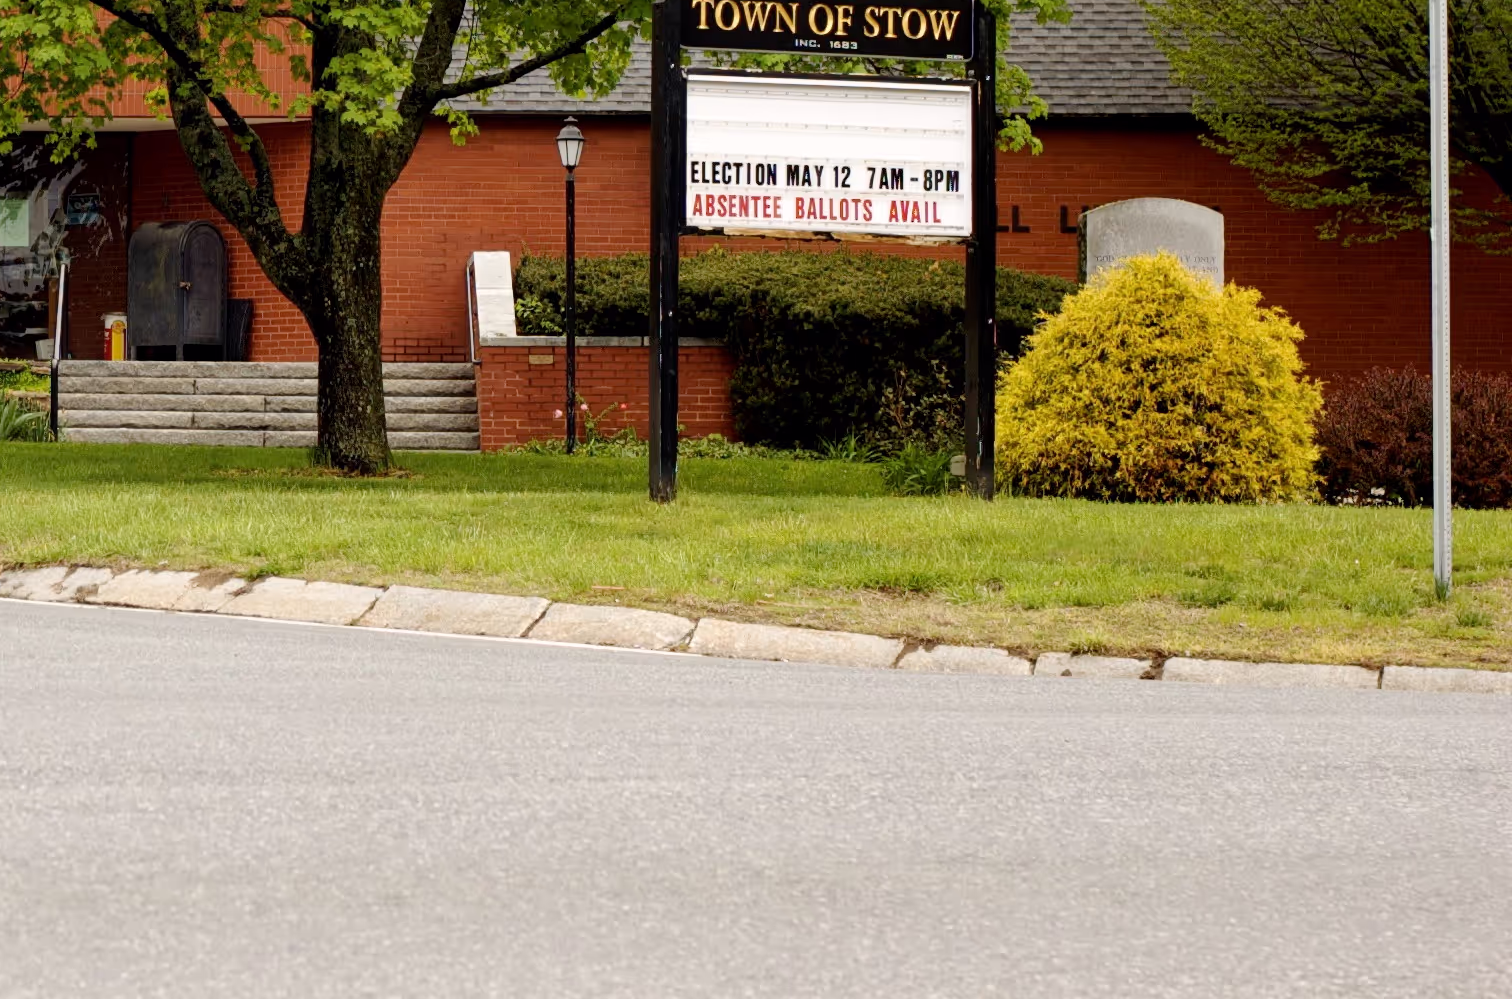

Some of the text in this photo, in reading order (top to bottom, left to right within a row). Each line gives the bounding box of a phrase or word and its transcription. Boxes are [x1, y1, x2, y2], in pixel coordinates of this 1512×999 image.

[808, 4, 854, 36] OF
[863, 6, 960, 40] STOW
[794, 38, 858, 50] INC. 1683
[691, 161, 777, 186] ELECTION
[786, 165, 823, 187] MAY
[833, 166, 851, 188] 12
[692, 194, 942, 223] ABSENTEE BALLOTS AVAIL
